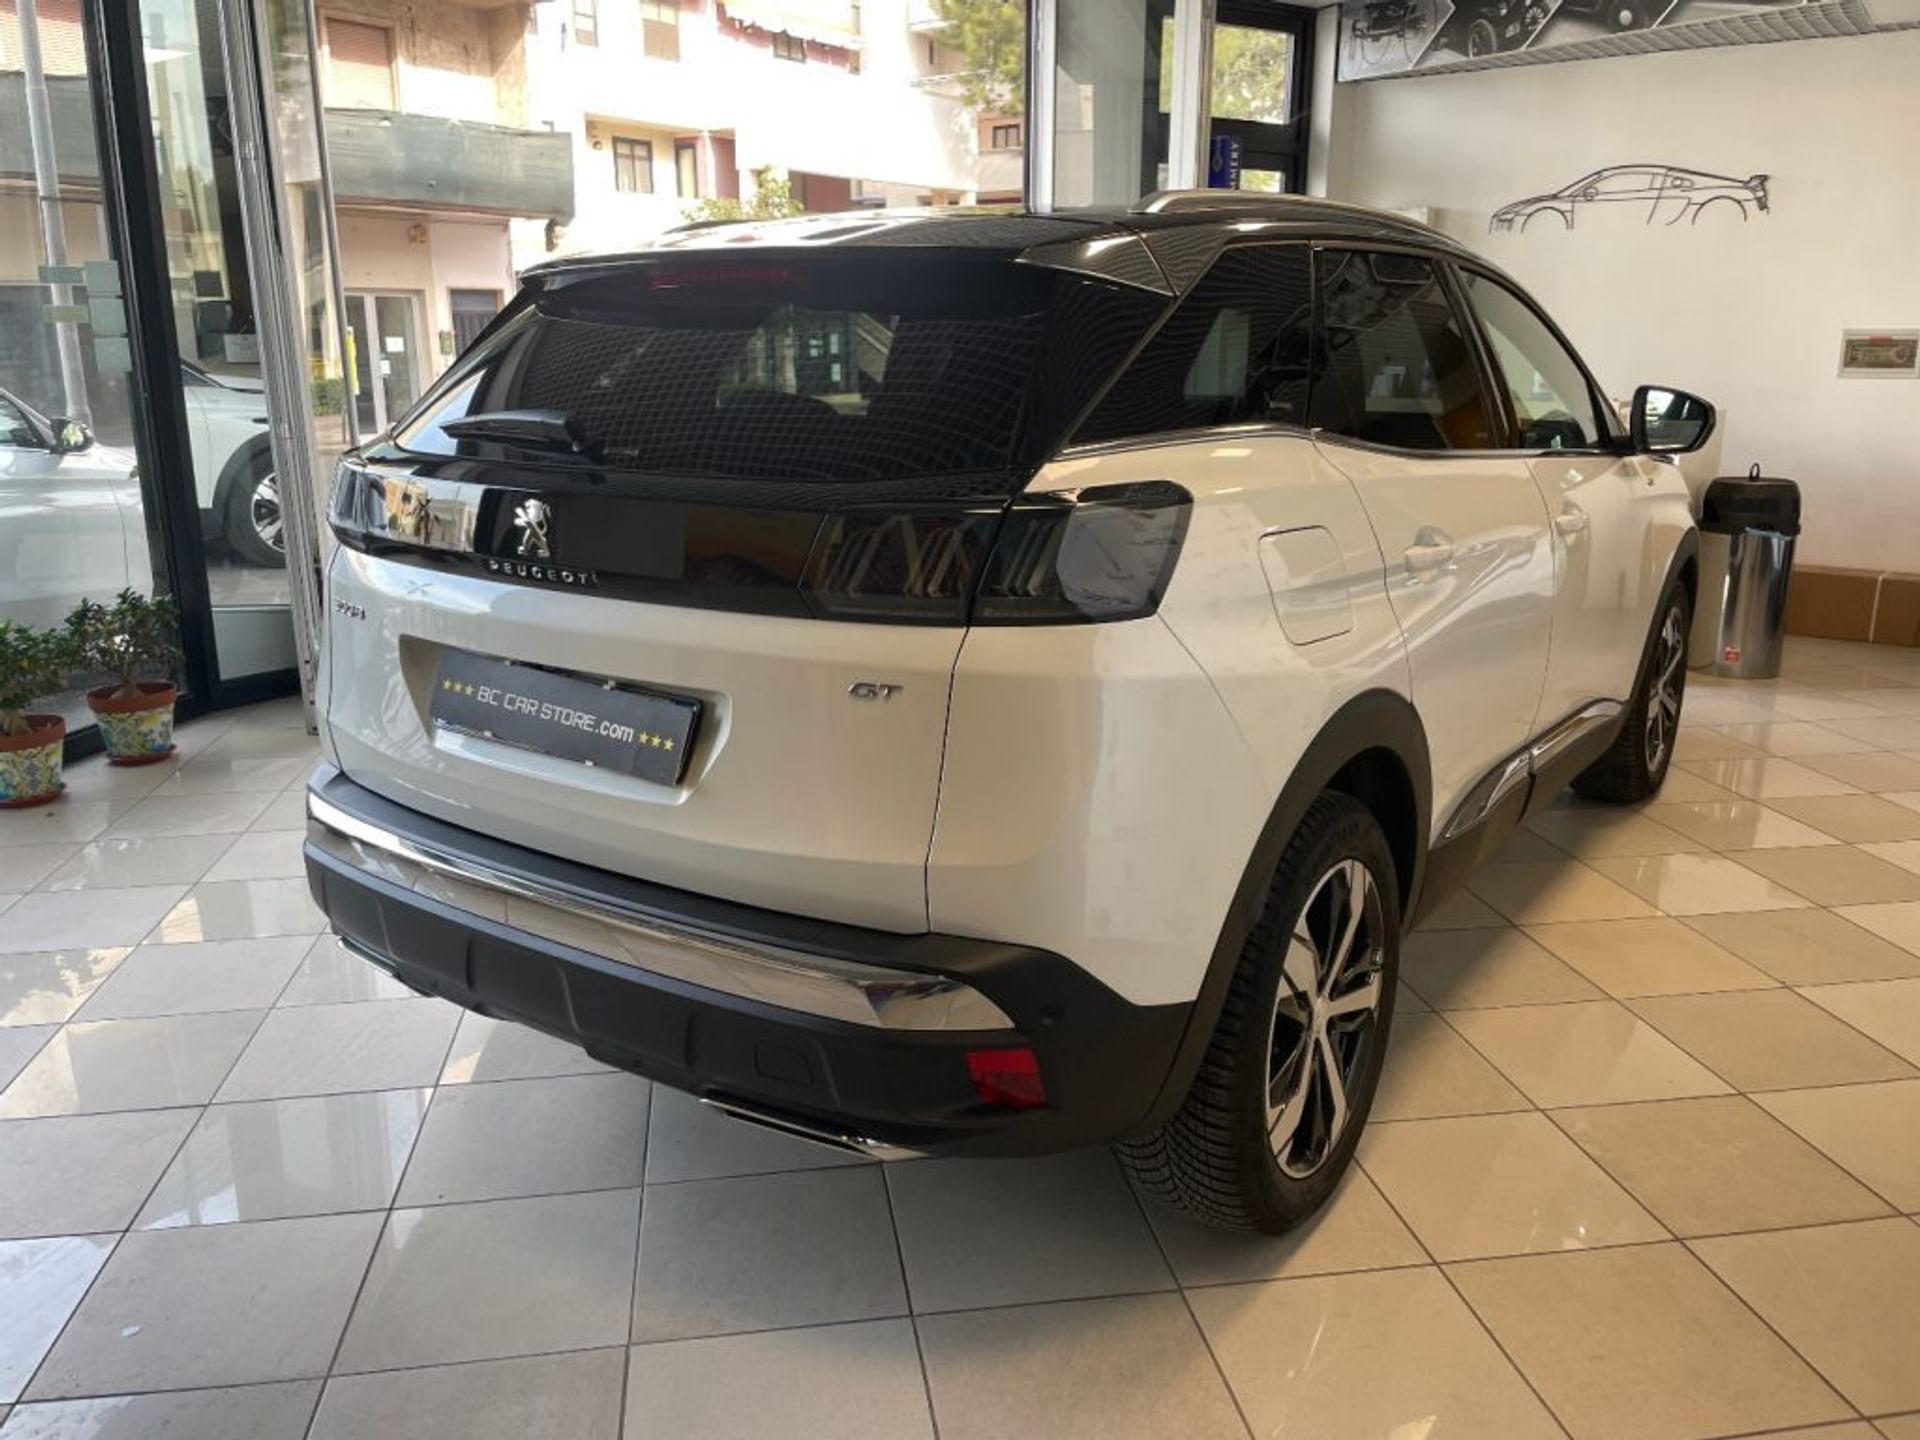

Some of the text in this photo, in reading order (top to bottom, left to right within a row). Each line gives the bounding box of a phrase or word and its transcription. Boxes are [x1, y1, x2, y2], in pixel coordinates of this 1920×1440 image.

[488, 560, 589, 585] PEUGEOT
[847, 681, 904, 703] GT
[477, 685, 635, 743] BC CAR STORE.com
